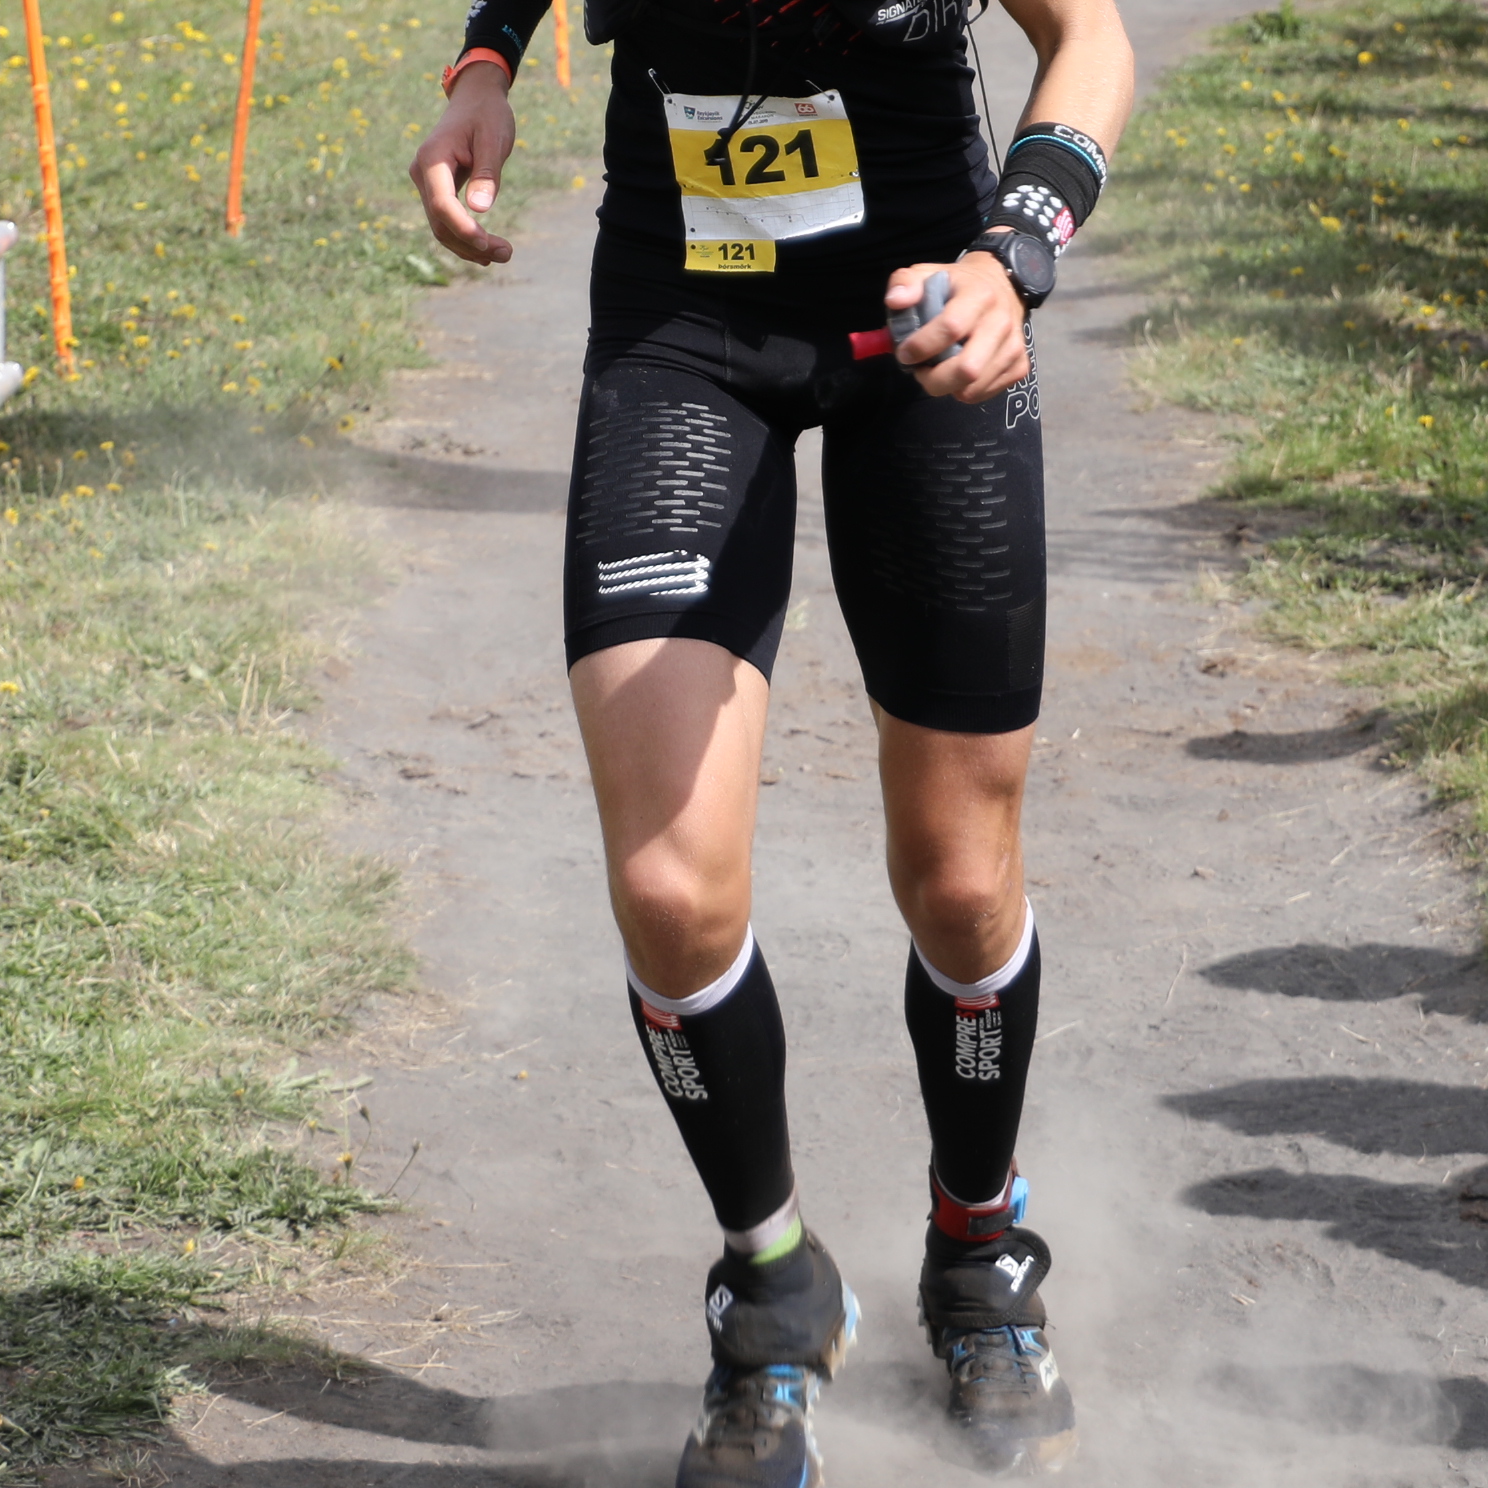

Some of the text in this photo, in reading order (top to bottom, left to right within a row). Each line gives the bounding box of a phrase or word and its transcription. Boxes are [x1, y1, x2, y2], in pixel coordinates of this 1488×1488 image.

[704, 128, 820, 186] 121
[718, 243, 756, 261] 121
[667, 1045, 709, 1100] SPORT
[977, 1028, 1003, 1081] SPORT
